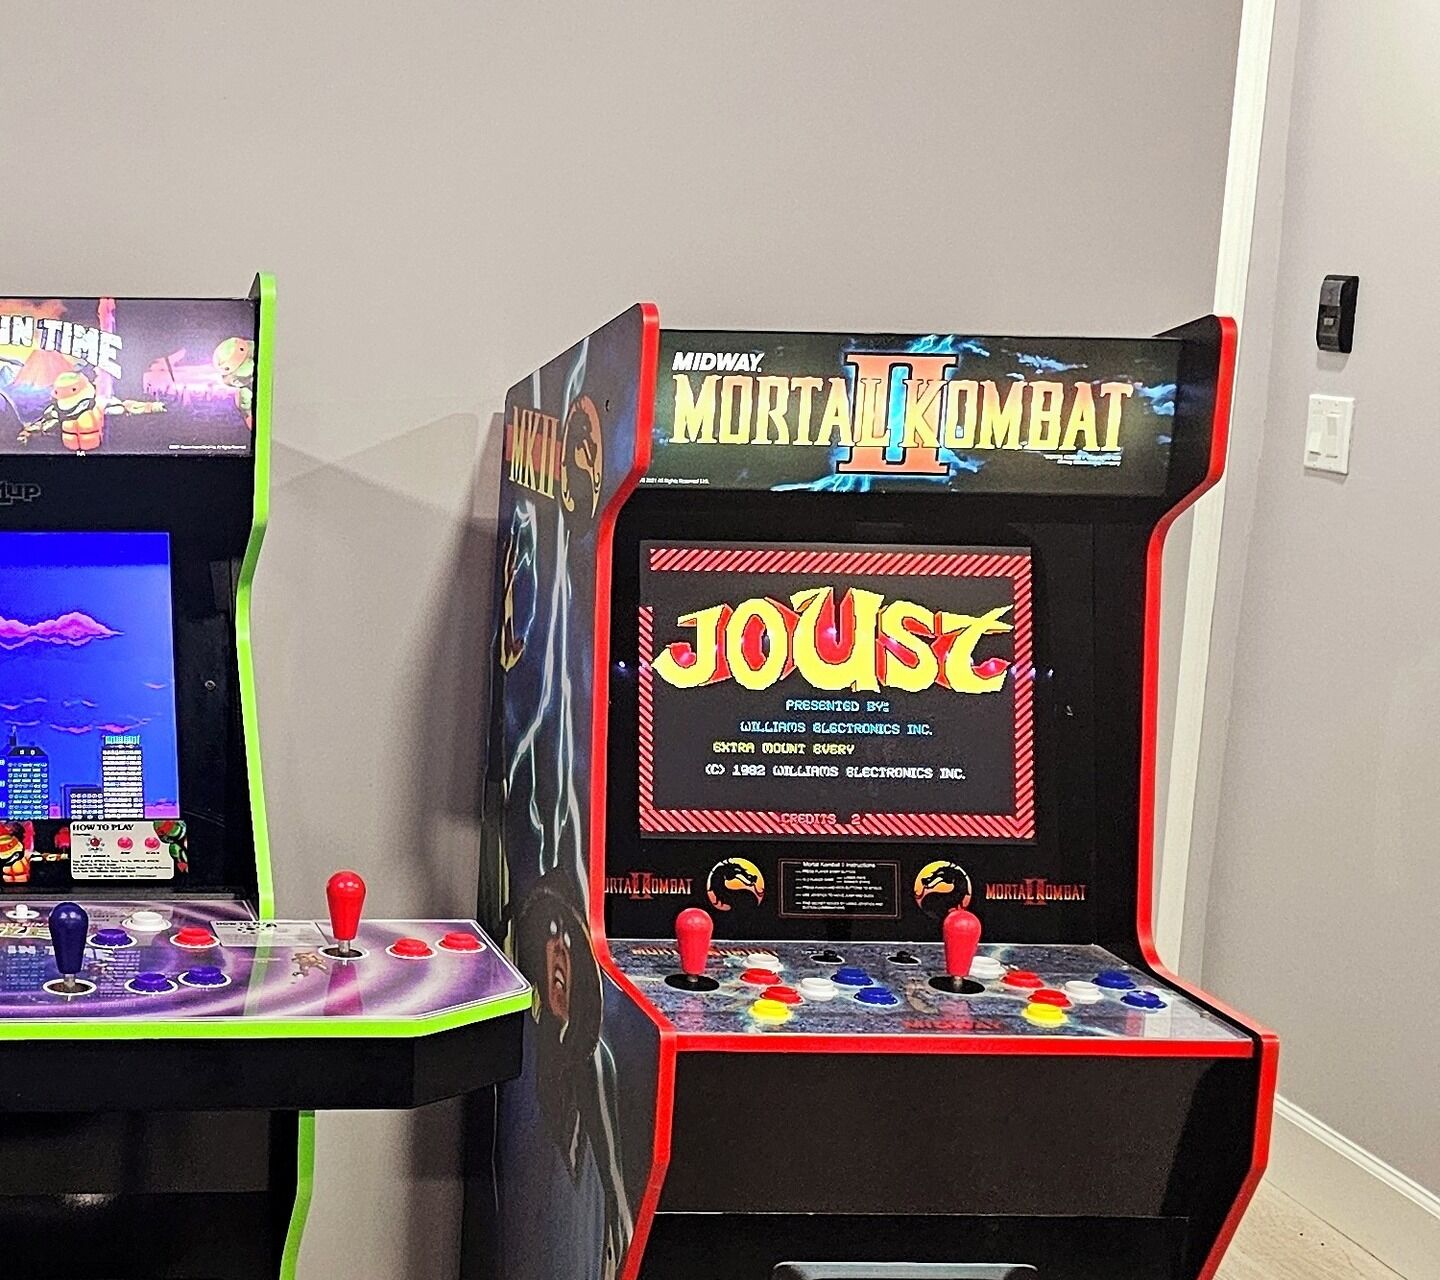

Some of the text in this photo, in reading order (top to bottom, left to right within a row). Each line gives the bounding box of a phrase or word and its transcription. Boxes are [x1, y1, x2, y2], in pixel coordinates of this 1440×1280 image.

[36, 319, 123, 380] TIME
[669, 374, 1134, 451] MORTAL KOMBAT
[836, 352, 959, 475] II
[652, 586, 1014, 694] JOUST
[785, 699, 860, 712] PRESENTED
[740, 721, 933, 736] WILLIAMS ELECTRONICS INC.
[713, 742, 855, 755] EXTRA MOUNT EVERY
[772, 765, 839, 778] WILLIAMS
[845, 766, 933, 779] ELECTRONICS
[939, 767, 966, 780] INC.
[72, 823, 134, 831] HOW TO PLAY
[985, 883, 1086, 901] MORTAL KOMBAT
[6, 944, 37, 955] IN
